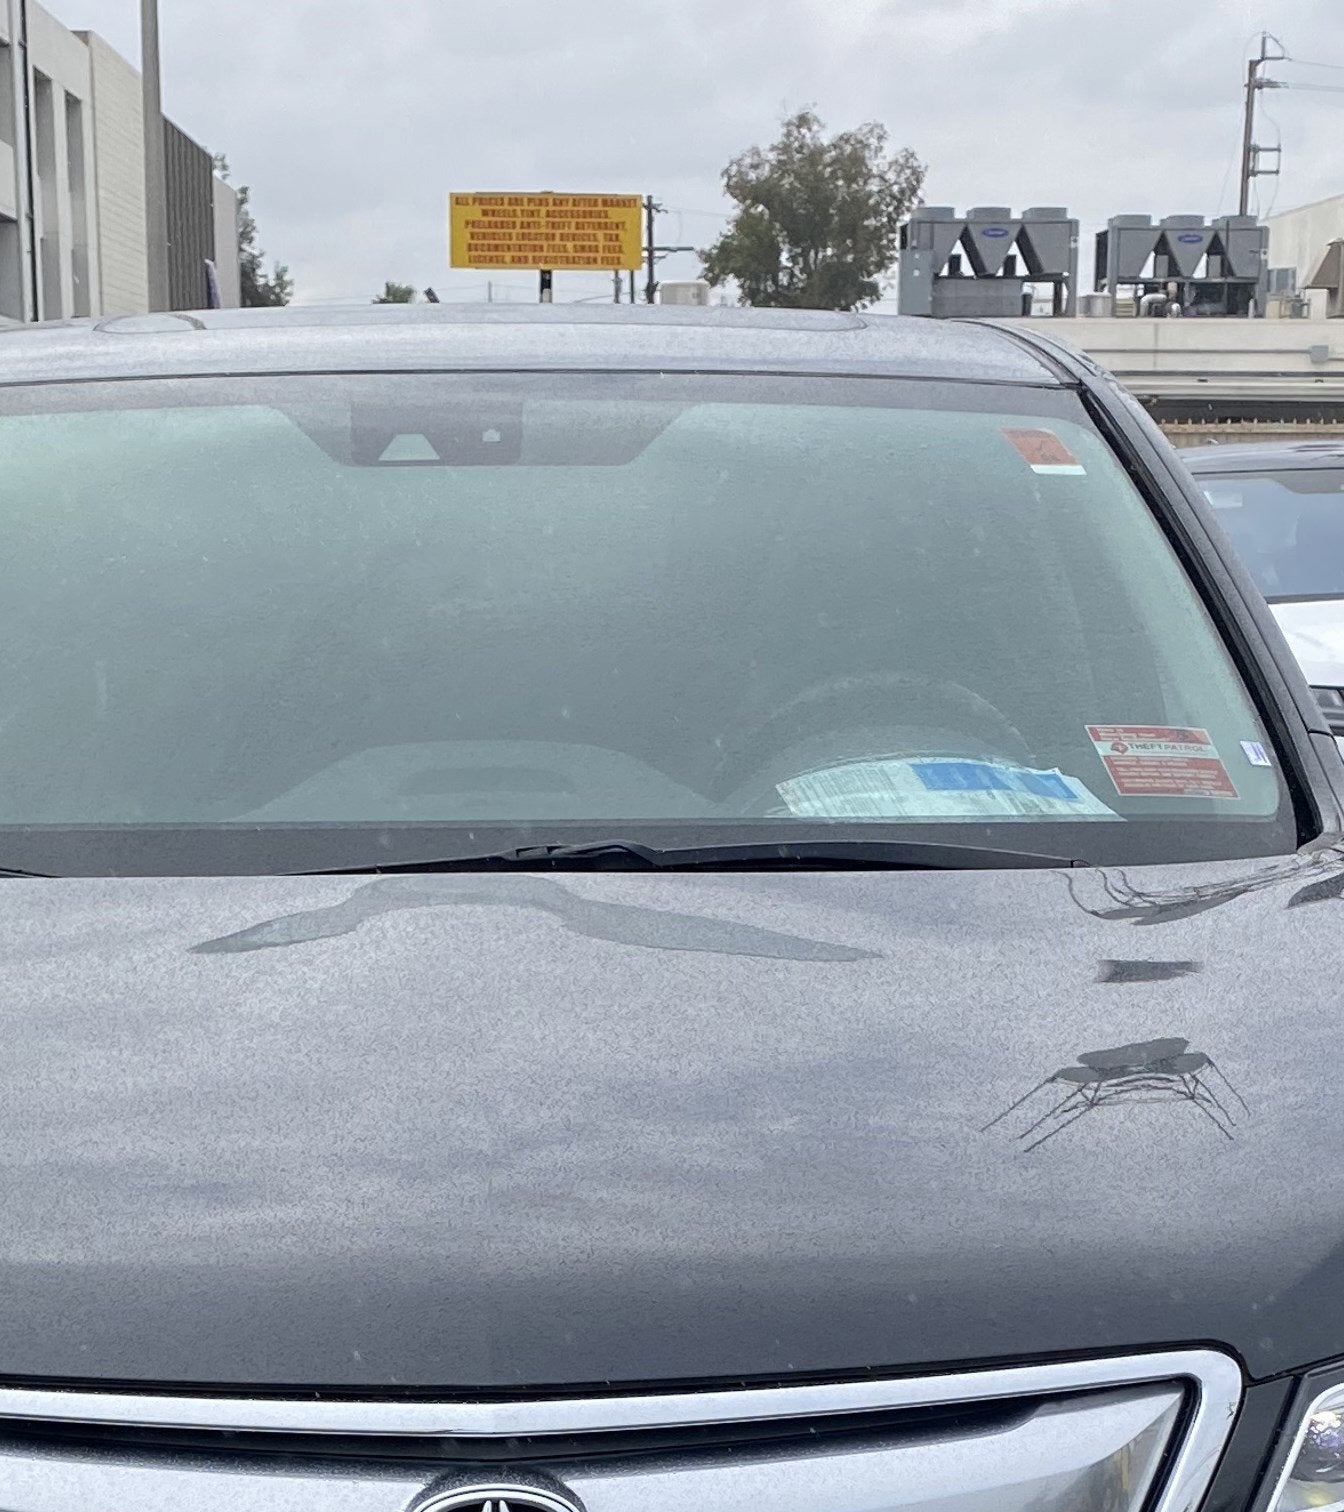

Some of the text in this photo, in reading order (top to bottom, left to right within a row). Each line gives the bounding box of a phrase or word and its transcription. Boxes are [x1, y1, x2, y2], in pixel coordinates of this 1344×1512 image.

[455, 197, 637, 207] ALL PRICES ARE PLUS ANY AFTER MARKET
[467, 243, 544, 253] DOCUMENTATION
[511, 254, 529, 265] AND
[532, 254, 598, 265] REGISTRATION
